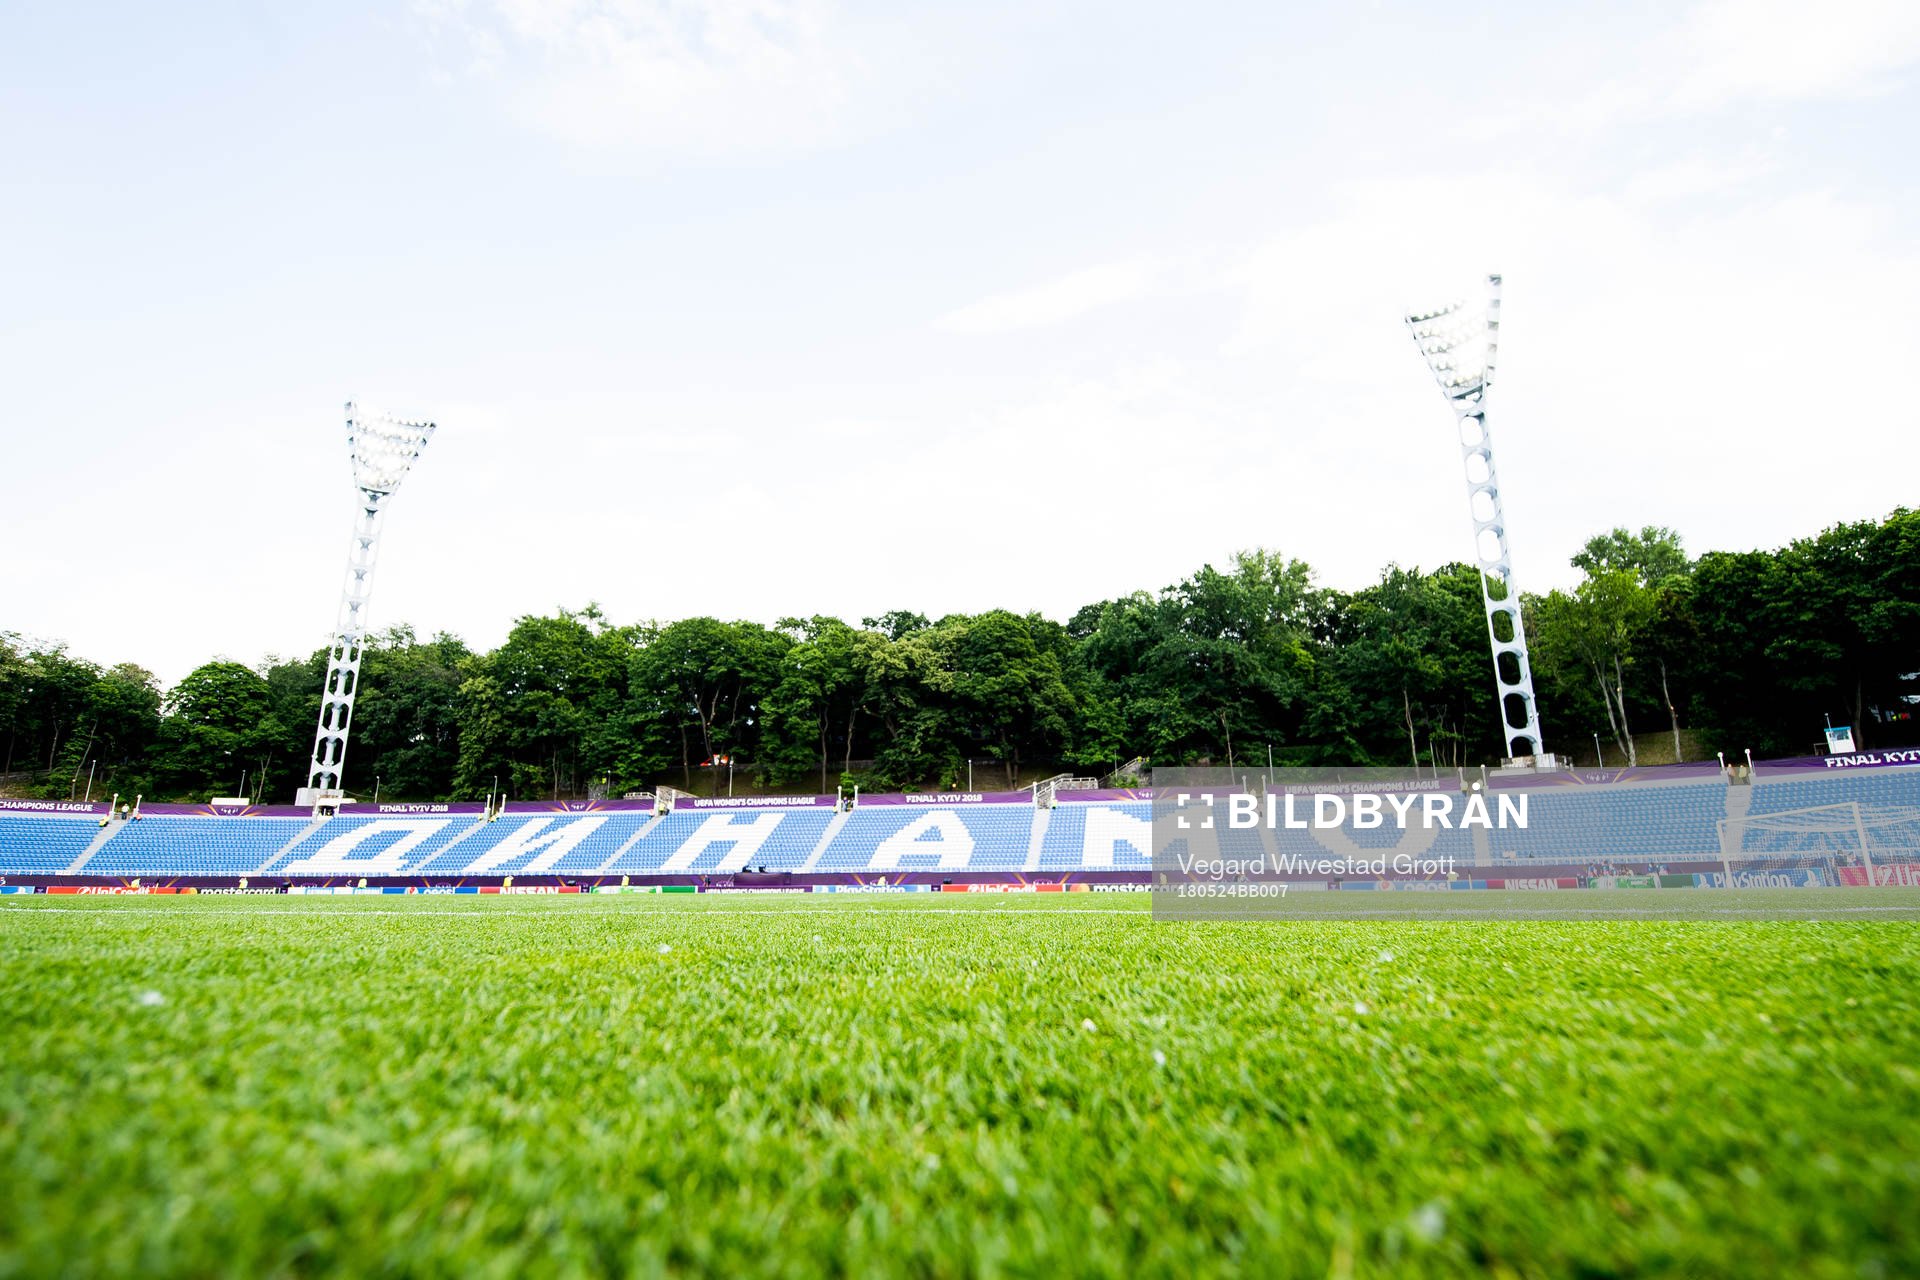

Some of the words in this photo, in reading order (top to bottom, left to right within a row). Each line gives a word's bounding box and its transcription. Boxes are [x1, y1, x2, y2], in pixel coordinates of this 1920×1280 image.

[1824, 754, 1881, 767] FINAL
[1351, 782, 1404, 793] CHAMPIONS
[1405, 780, 1440, 790] LEAGUE
[747, 797, 787, 806] CHAMPIONS
[788, 797, 816, 805] LEAGUE
[905, 795, 936, 803] FINAL
[937, 794, 960, 803] KYIV
[962, 794, 983, 802] 2018
[56, 803, 93, 811] LEAGUE
[430, 804, 449, 812] 2018
[1504, 878, 1558, 890] NISSAN
[1713, 872, 1791, 888] PlyStation
[500, 886, 558, 894] NISSAN
